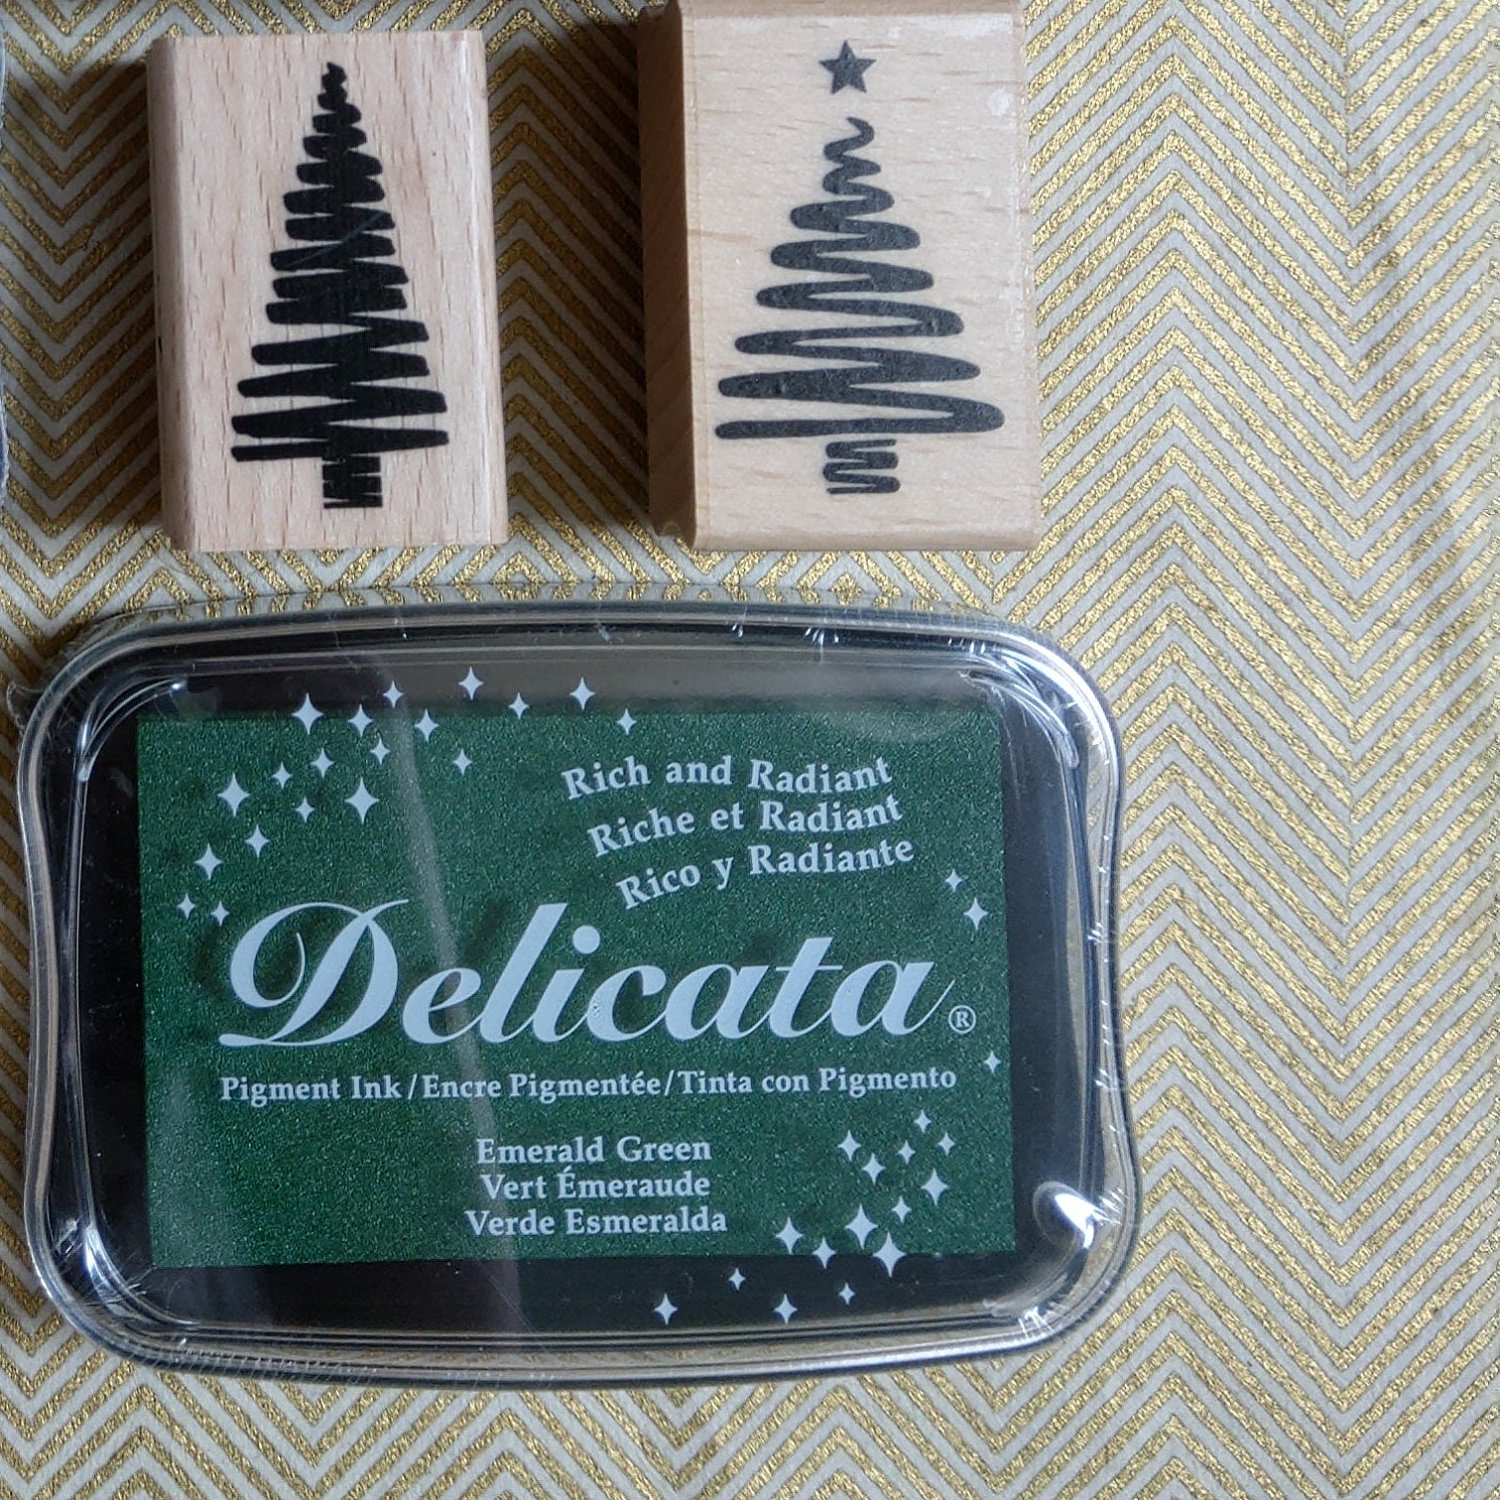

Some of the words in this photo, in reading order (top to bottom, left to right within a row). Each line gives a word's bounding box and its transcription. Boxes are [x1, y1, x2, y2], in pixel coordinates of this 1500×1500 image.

[560, 755, 651, 799] Rich
[665, 755, 732, 785] and
[748, 756, 892, 793] Radiant
[587, 807, 695, 858] Riche
[710, 802, 744, 830] et
[759, 794, 903, 833] Radiant
[615, 863, 700, 910] Rico
[712, 856, 734, 890] y
[748, 839, 914, 875] Radiante
[219, 1076, 340, 1107] Pigment
[761, 1073, 810, 1093] con
[818, 1066, 957, 1098] Pigmento
[476, 1137, 605, 1164] Emerald
[616, 1135, 712, 1163] Green
[480, 1172, 547, 1200] Vert
[557, 1165, 711, 1198] Émeraude
[464, 1209, 555, 1236] Verde
[565, 1205, 728, 1235] Esmeralda
